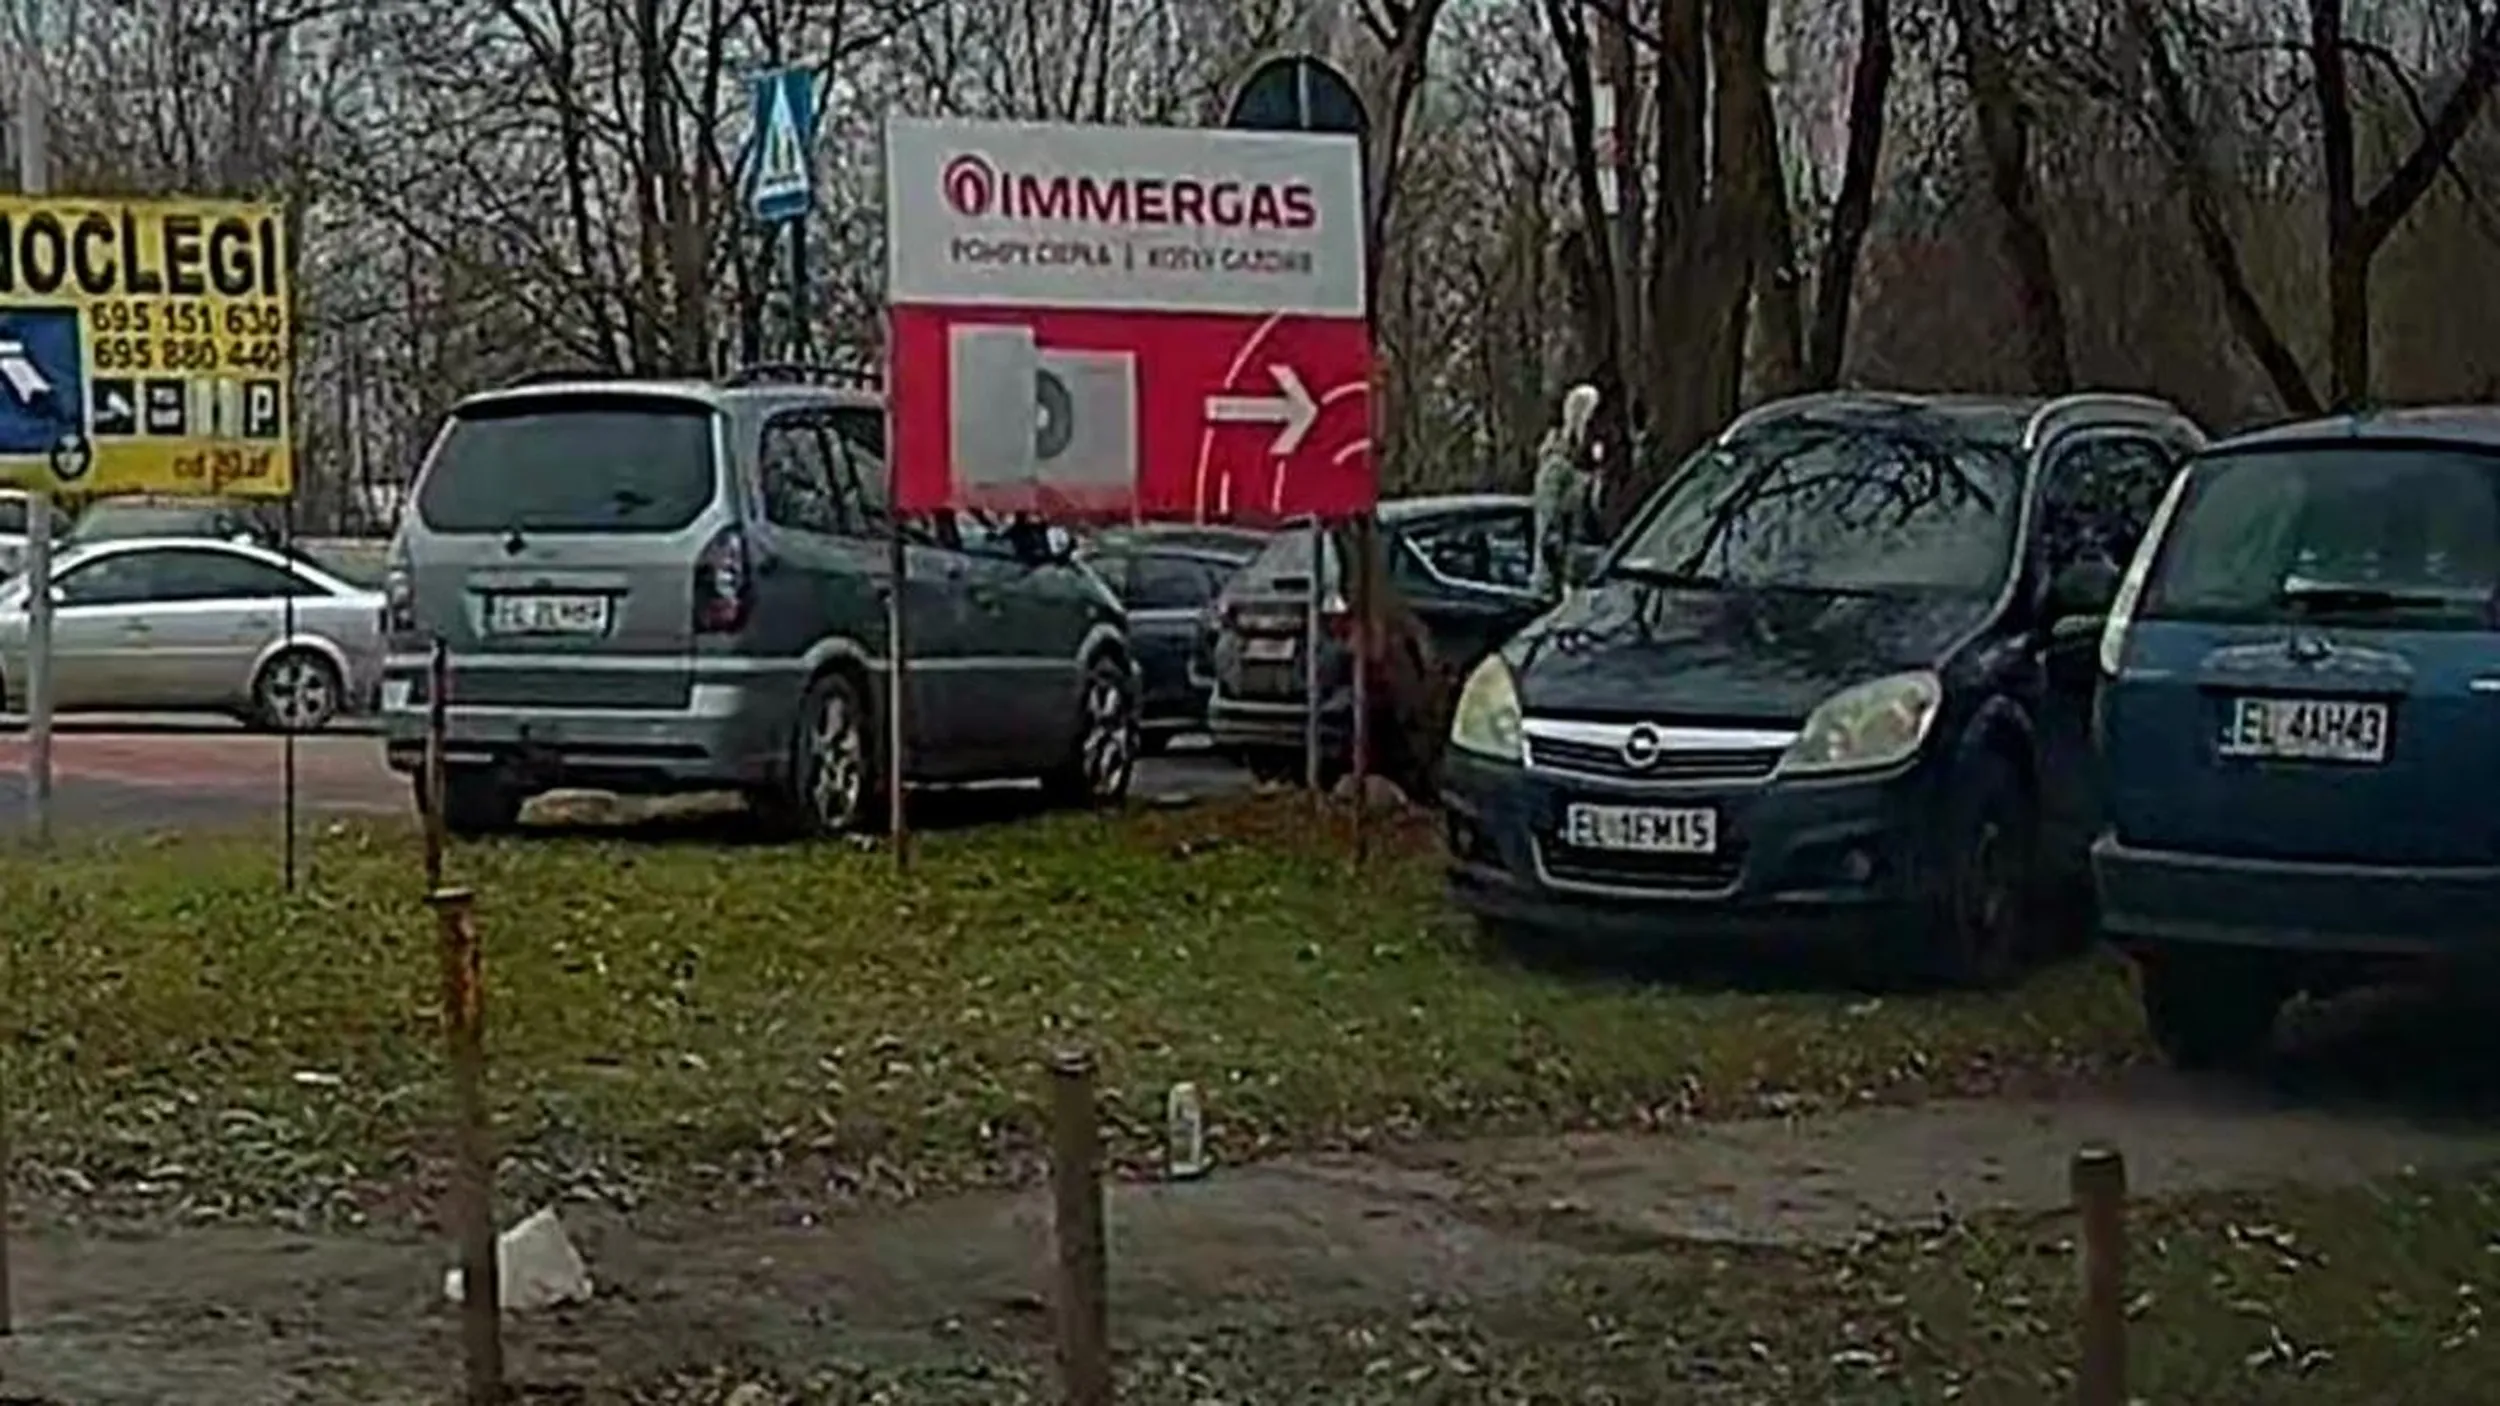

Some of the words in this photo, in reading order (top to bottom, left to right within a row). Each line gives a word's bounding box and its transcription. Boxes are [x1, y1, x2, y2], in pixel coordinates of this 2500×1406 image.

[1001, 171, 1317, 230] IMMERGAS
[91, 301, 151, 333] 695
[163, 303, 213, 335] 151
[224, 304, 281, 336] 630
[94, 337, 152, 370] 695
[161, 338, 218, 370] 880
[223, 341, 281, 372] 440
[2241, 702, 2274, 746] EL
